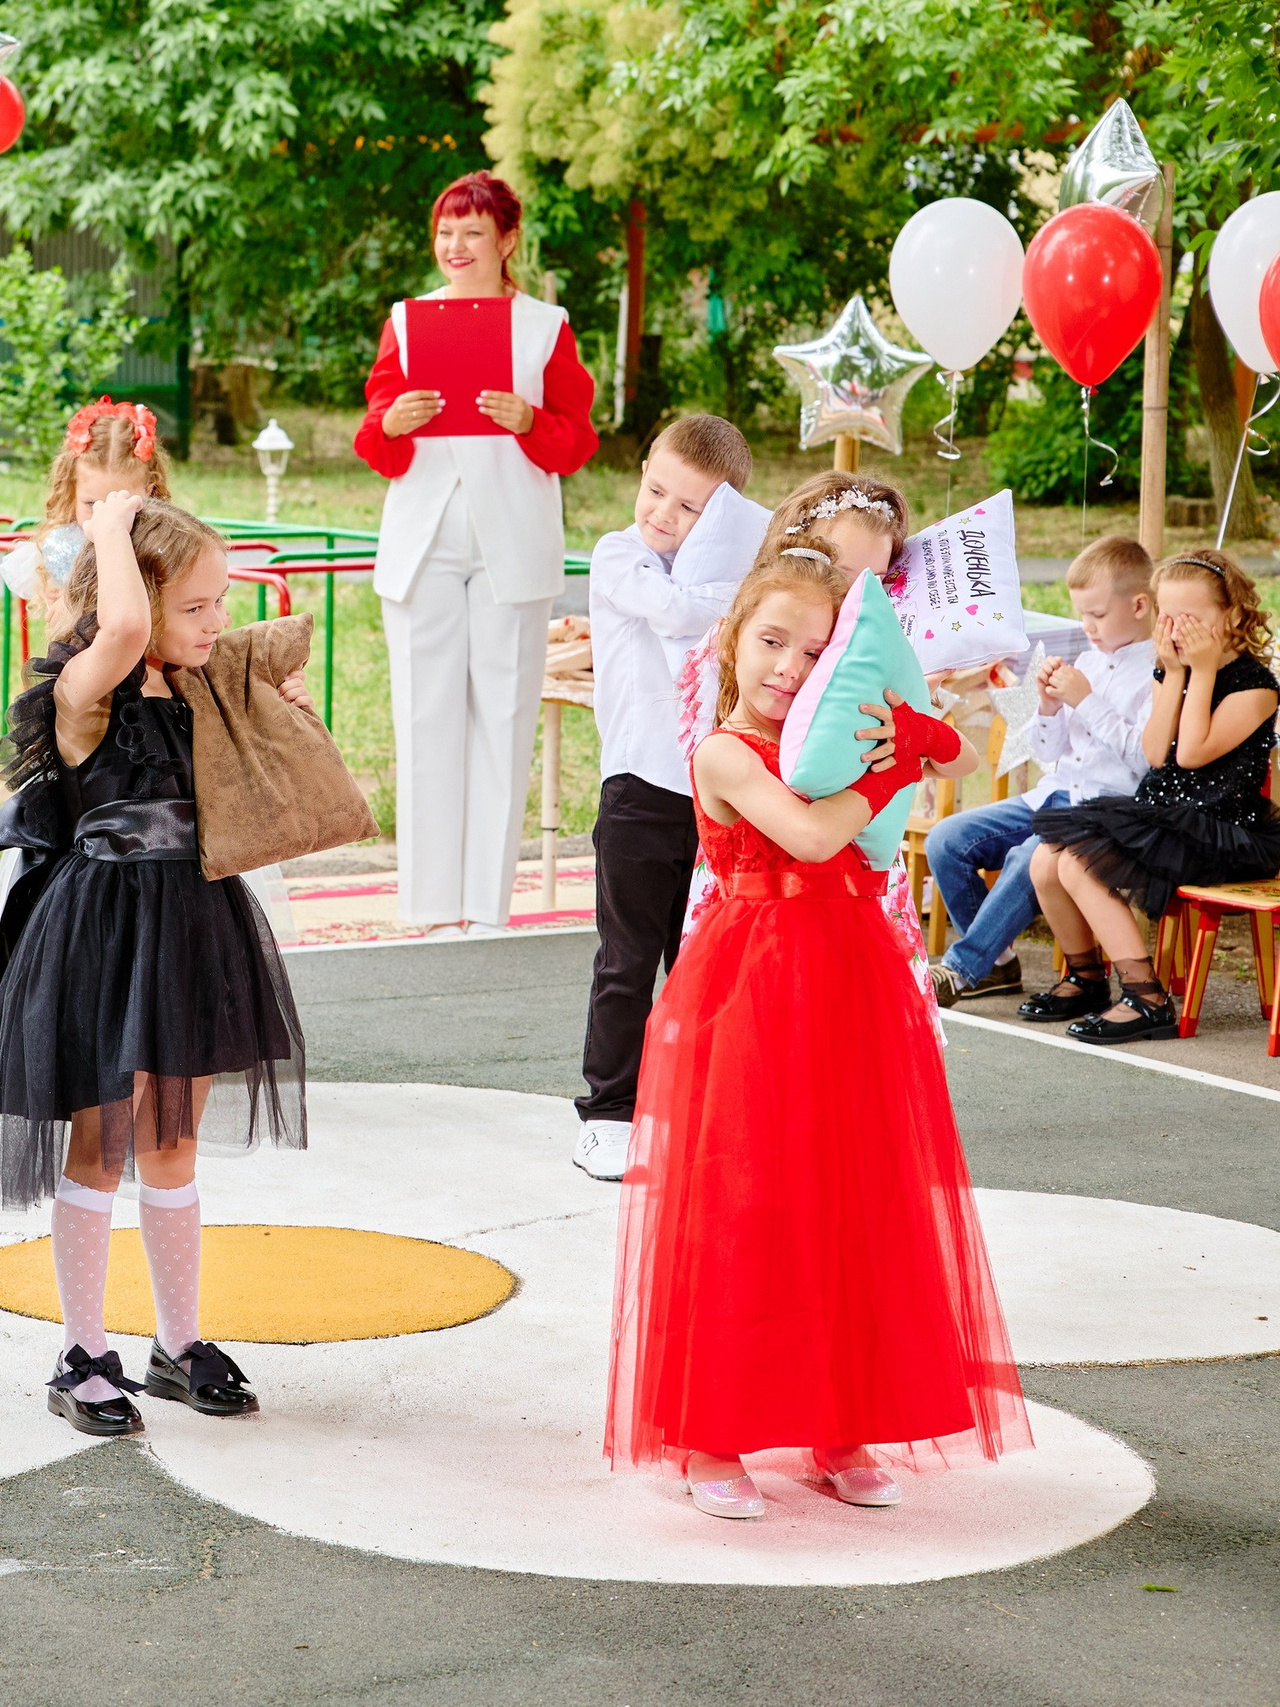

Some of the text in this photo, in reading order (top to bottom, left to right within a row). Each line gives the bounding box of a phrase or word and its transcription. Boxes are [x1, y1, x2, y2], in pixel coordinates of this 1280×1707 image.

[956, 529, 996, 598] ДОЧЕНЬКА
[944, 578, 958, 595] ЕСТЬ
[946, 594, 959, 605] ТЫ
